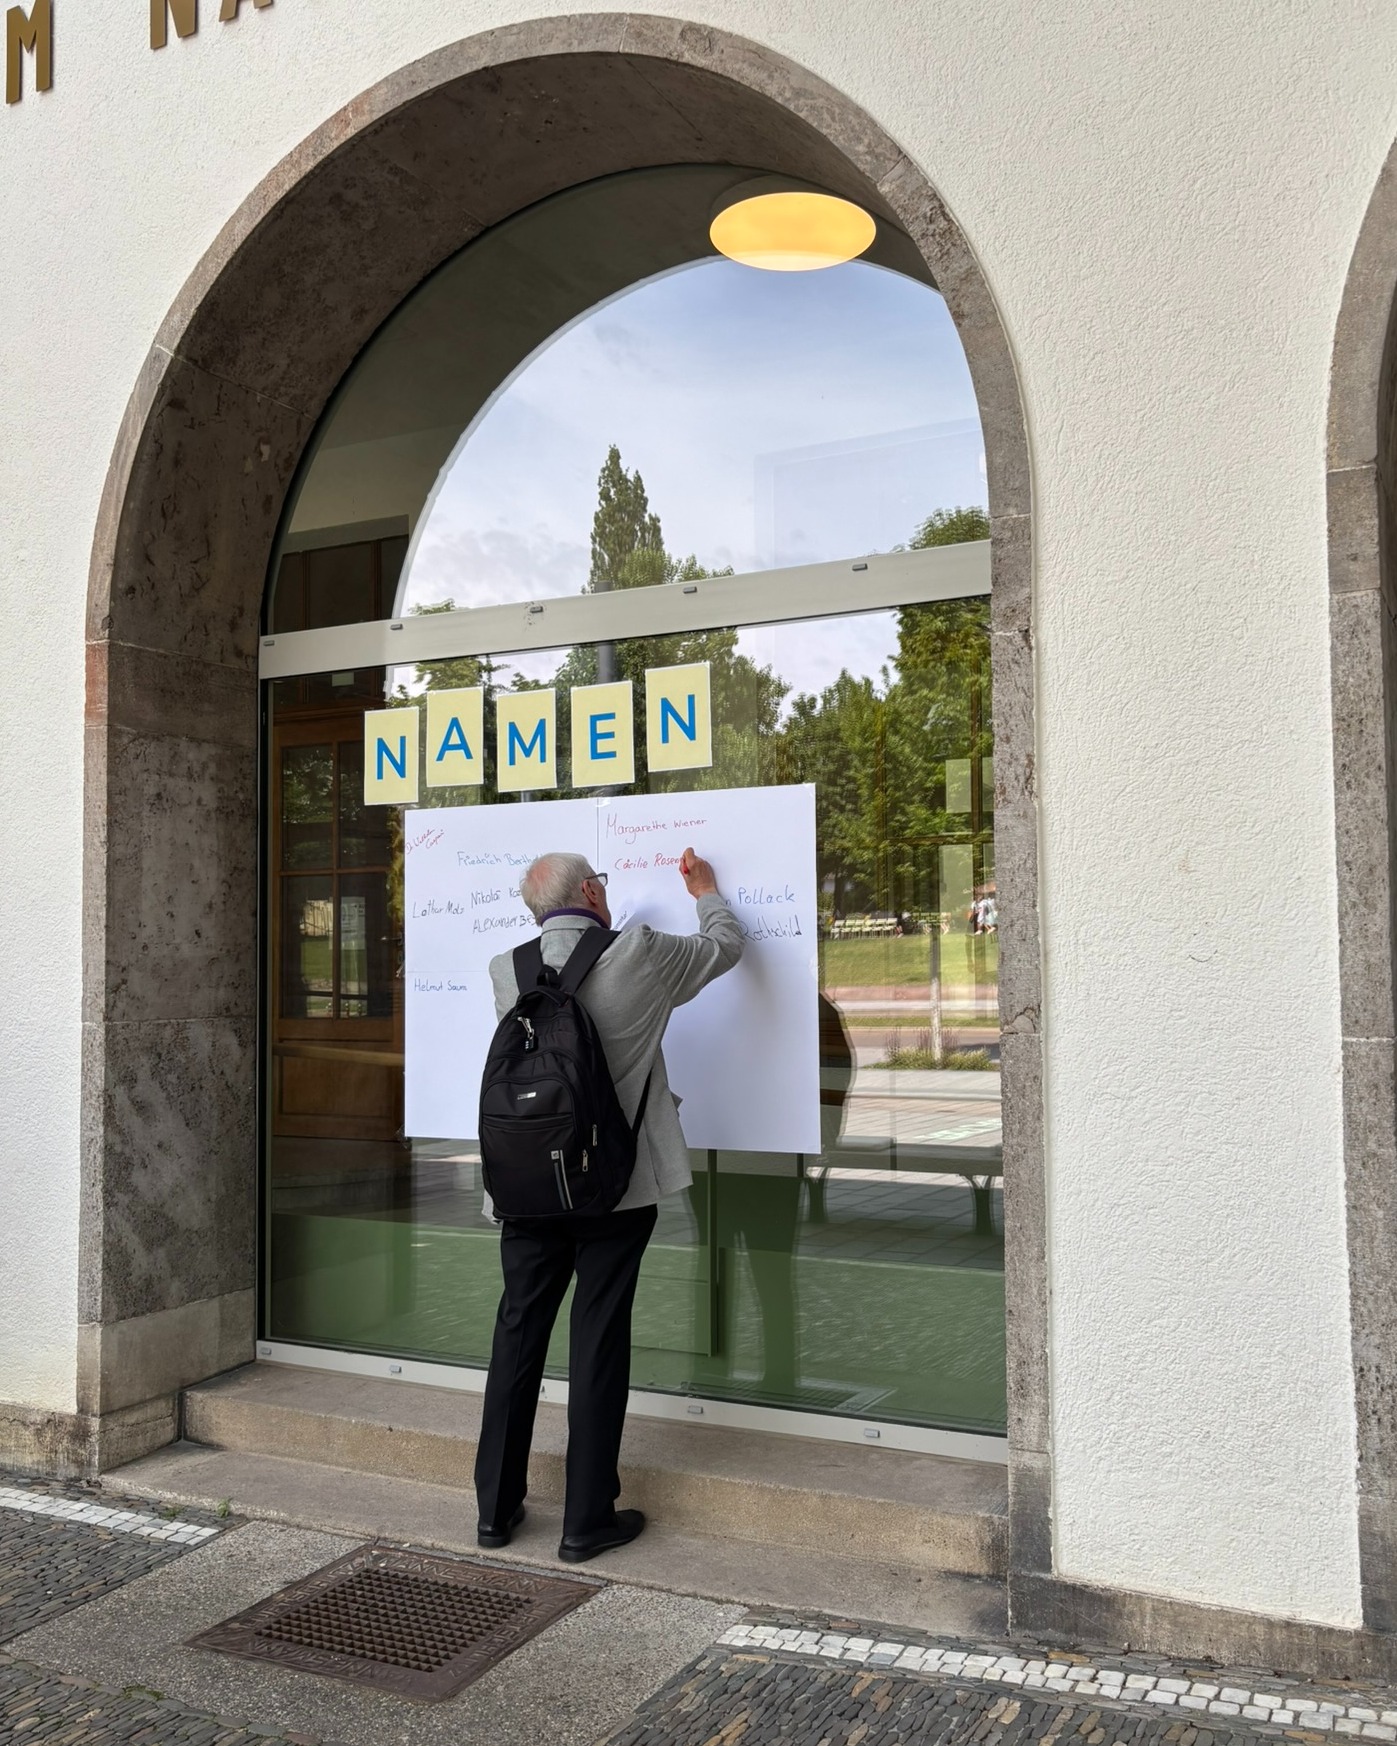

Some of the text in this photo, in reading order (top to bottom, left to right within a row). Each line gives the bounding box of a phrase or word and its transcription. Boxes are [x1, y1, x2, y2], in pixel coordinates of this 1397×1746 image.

[376, 693, 697, 780] NAMEN
[456, 850, 502, 867] Friedrich
[737, 883, 796, 906] Pollack
[414, 978, 448, 992] Helmut
